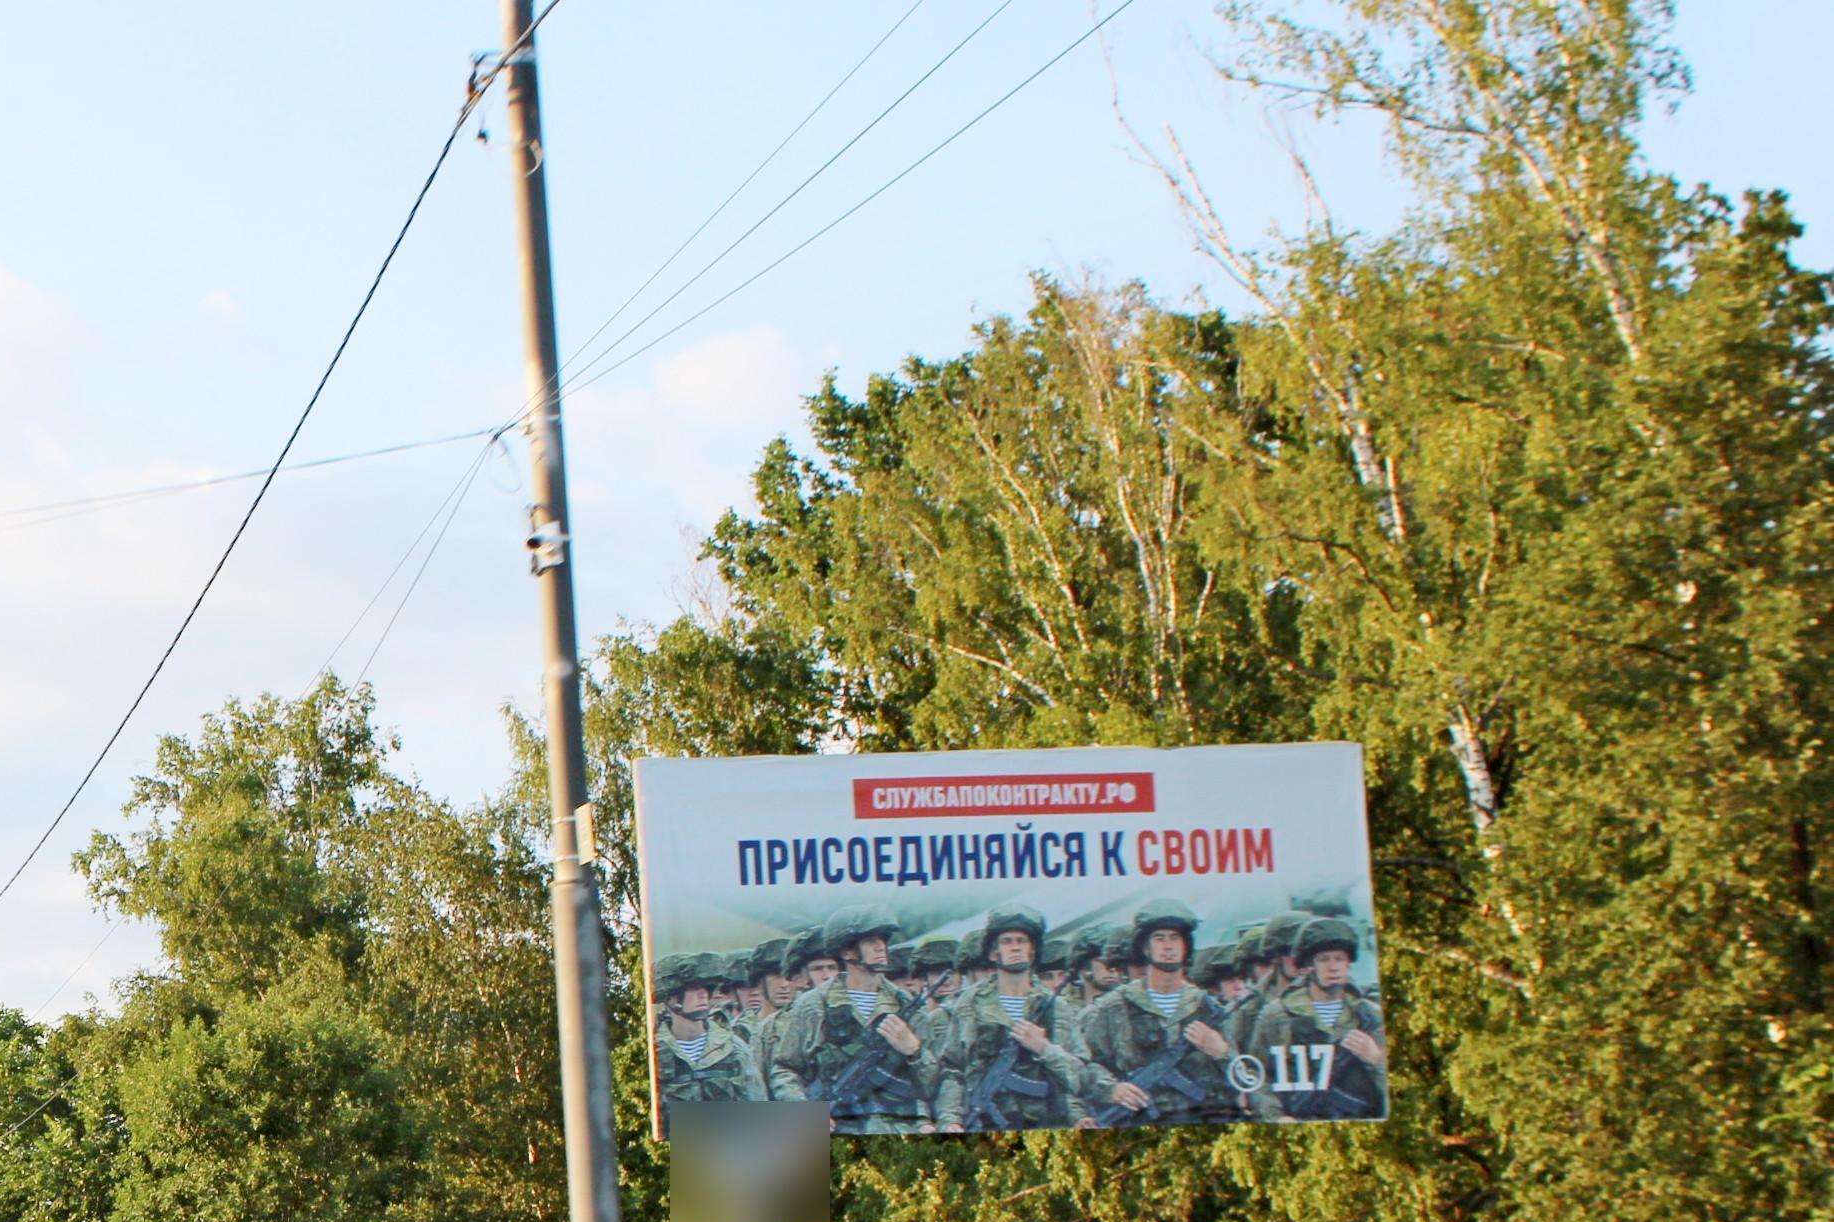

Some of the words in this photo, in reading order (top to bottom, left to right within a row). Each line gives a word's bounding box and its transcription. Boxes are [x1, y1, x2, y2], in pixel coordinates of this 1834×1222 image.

[872, 781, 1137, 810] СЛУЖБАПОКОНТРАКТУ.РФ
[738, 822, 1087, 887] ПРИСОЕДИНЯЙСЯ
[1101, 831, 1127, 876] К
[1137, 828, 1274, 875] СВОИМ
[1269, 1043, 1335, 1092] 117
